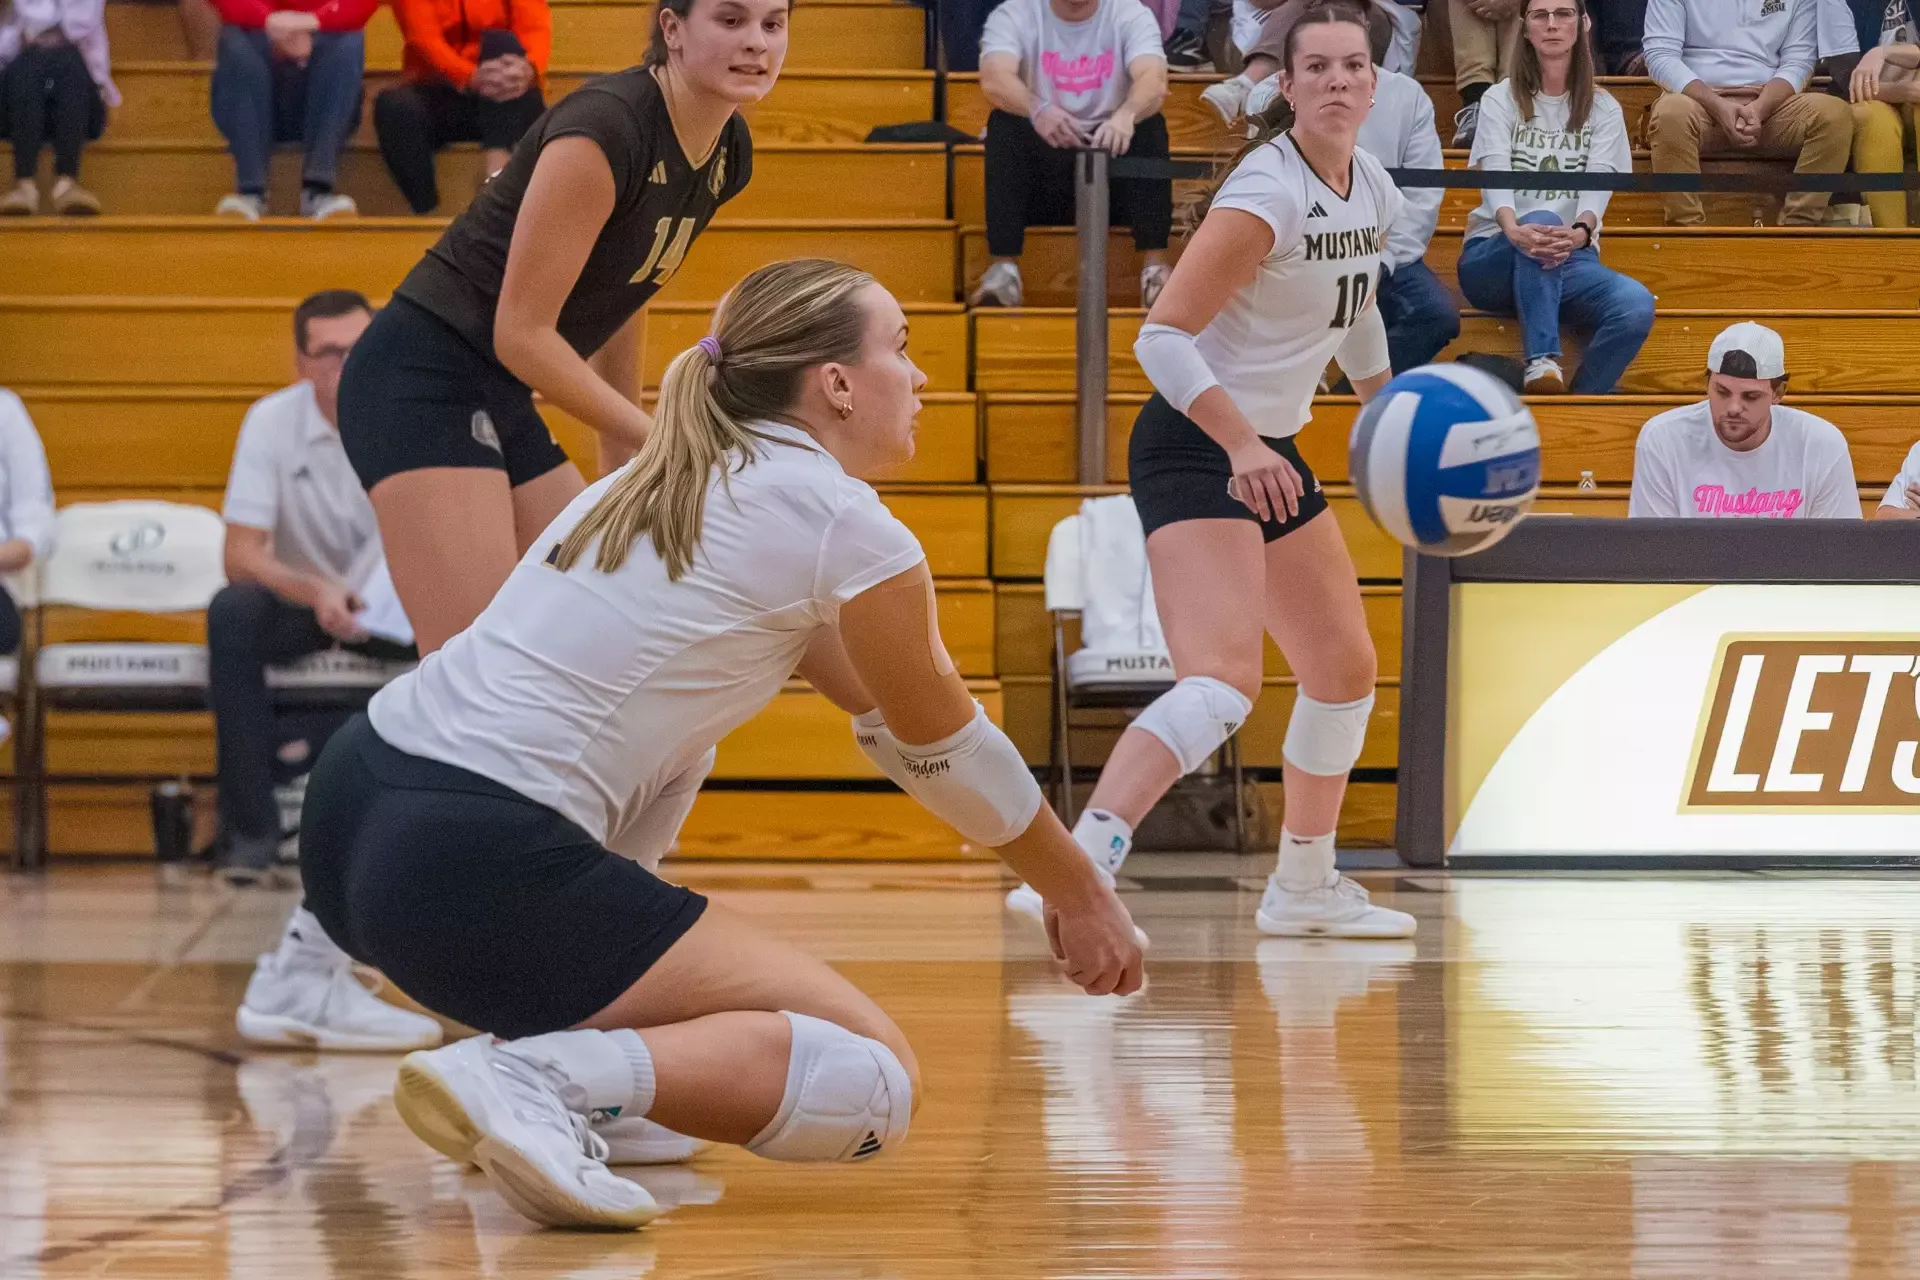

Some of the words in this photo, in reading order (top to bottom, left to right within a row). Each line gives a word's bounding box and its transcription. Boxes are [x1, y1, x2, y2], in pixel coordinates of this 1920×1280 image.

[628, 216, 696, 285] 14
[1303, 226, 1380, 261] MUSTANG
[1329, 273, 1369, 329] 10
[1693, 484, 1804, 518] Mustang
[1106, 656, 1171, 671] MUSTA
